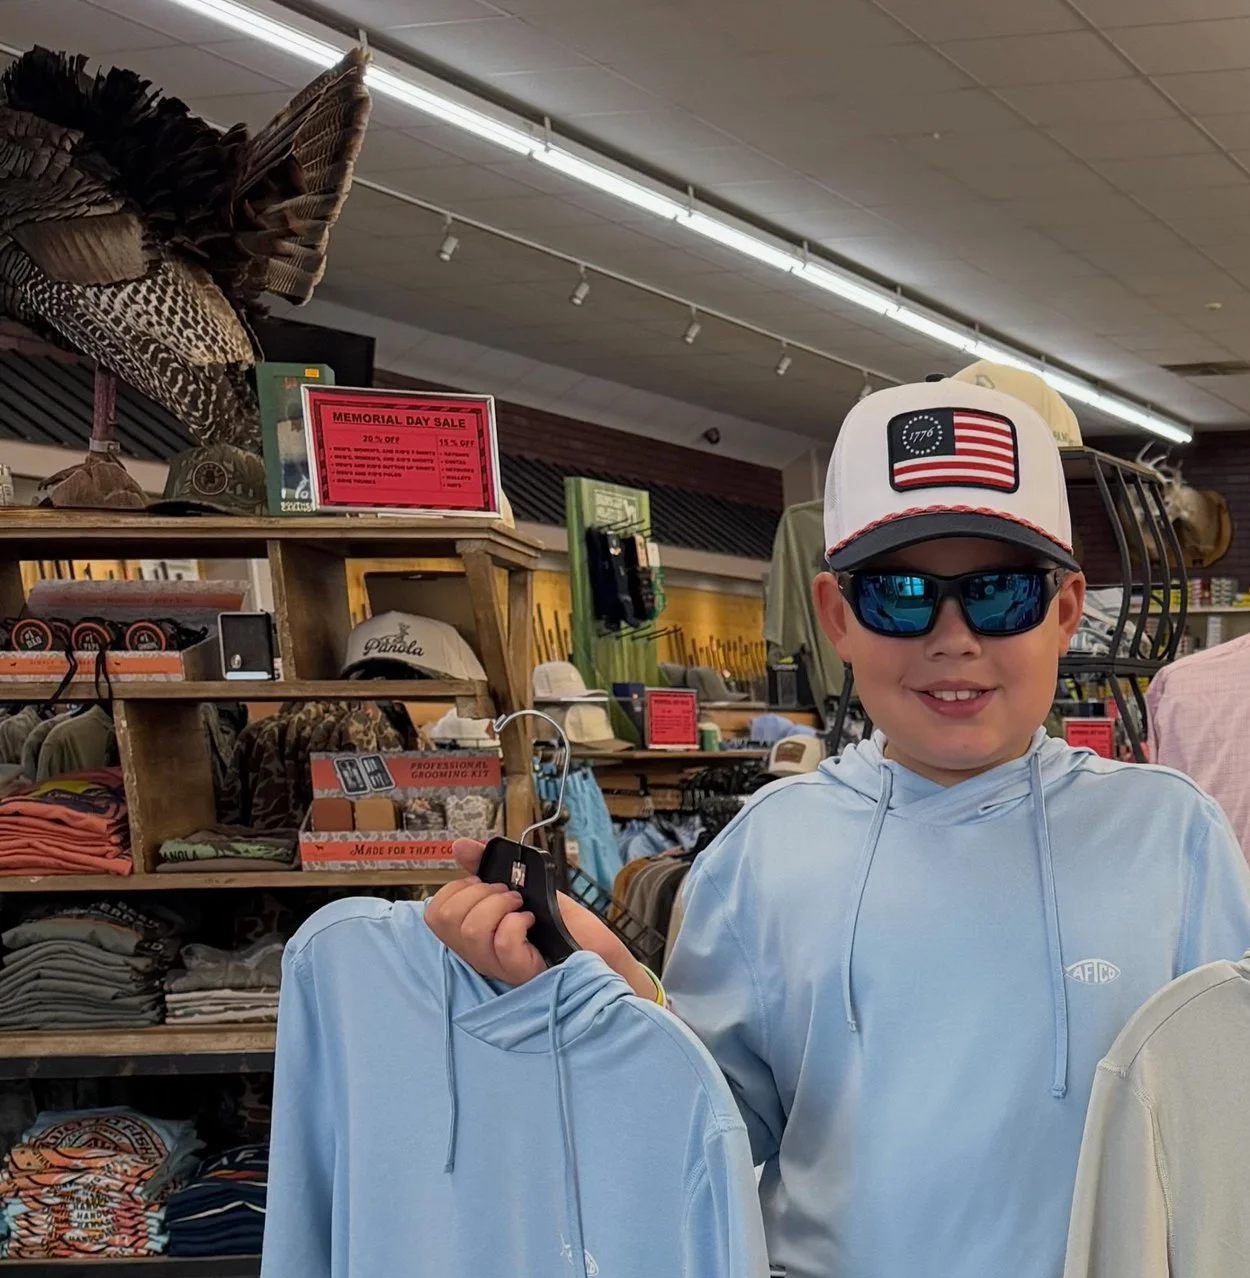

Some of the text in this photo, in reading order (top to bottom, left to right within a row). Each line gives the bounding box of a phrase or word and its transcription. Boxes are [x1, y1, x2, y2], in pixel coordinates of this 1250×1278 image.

[333, 412, 466, 428] MEMORIAL DAY SALE
[385, 436, 400, 444] OFF
[909, 426, 935, 443] 1776
[439, 438, 449, 446] 15
[460, 440, 475, 448] OFF
[363, 637, 425, 656] Panola
[410, 761, 489, 771] PROFESSIONAL
[411, 770, 490, 780] GROOMING KIT
[350, 844, 385, 856] MADE
[387, 846, 406, 856] FOR
[408, 846, 438, 856] THAT
[1070, 959, 1118, 984] AFTCO
